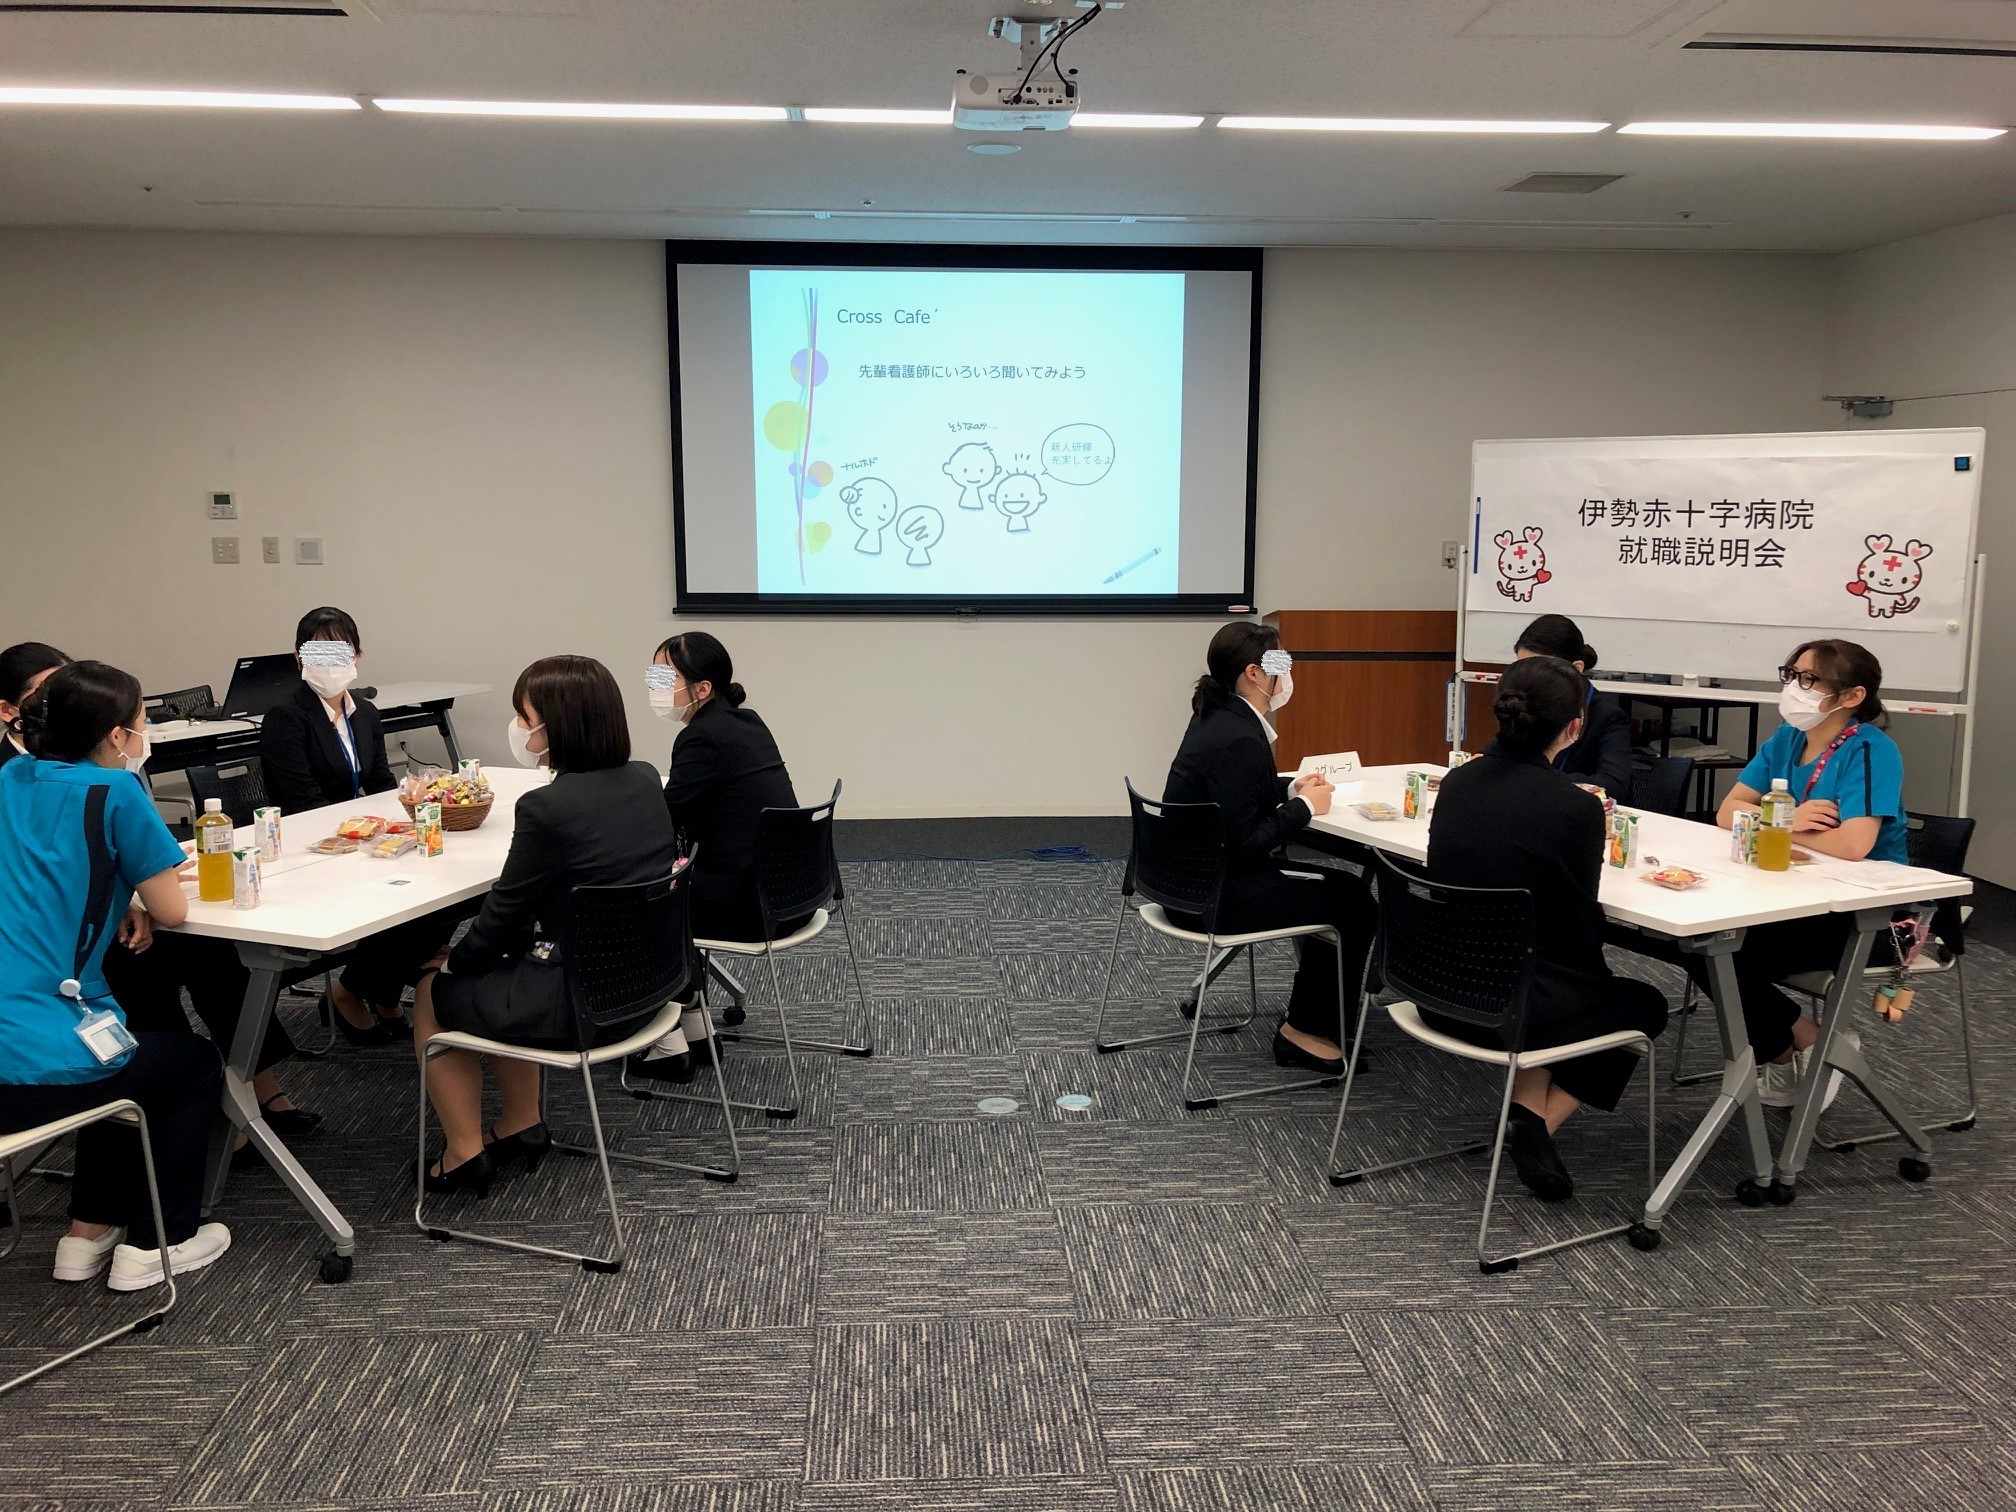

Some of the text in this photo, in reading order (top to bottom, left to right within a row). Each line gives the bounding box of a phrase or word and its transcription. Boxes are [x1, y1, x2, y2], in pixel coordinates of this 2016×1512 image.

[837, 309, 882, 324] Cross
[858, 364, 1086, 379] 先輩看護師にいろいろ聞いてみよう
[1051, 442, 1092, 453] 新人研修
[841, 456, 879, 471] ナルホド
[1051, 455, 1112, 465] 充実してるよ
[1578, 498, 1814, 530] 伊勢赤十字病院
[1618, 535, 1786, 568] 就職説明会
